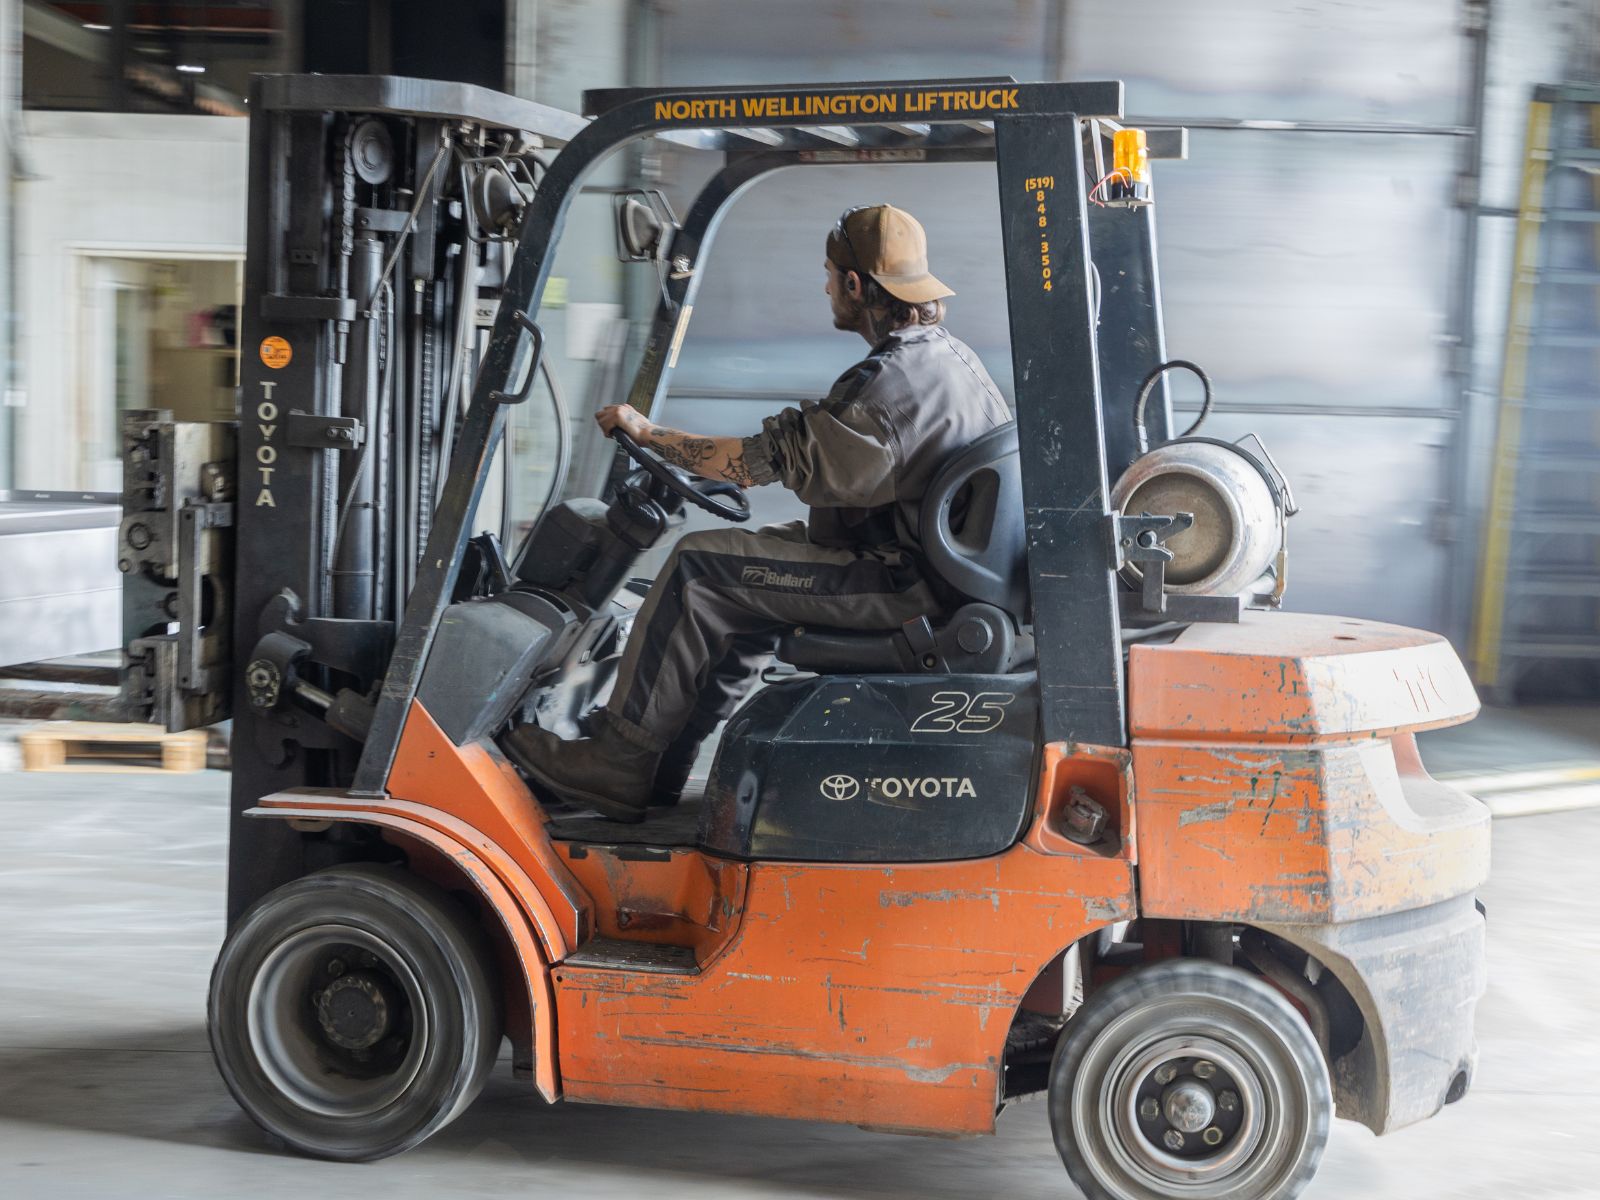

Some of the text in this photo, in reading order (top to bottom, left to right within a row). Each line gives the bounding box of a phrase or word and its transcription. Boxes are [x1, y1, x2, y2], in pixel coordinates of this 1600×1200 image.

[655, 89, 1019, 120] NORTH WELLINGTON LIFTRUCK
[1025, 176, 1054, 192] (519)
[1036, 190, 1053, 292] 848-3504
[255, 381, 279, 508] TOYOTA
[765, 571, 815, 589] Bullard
[910, 691, 1016, 733] 25
